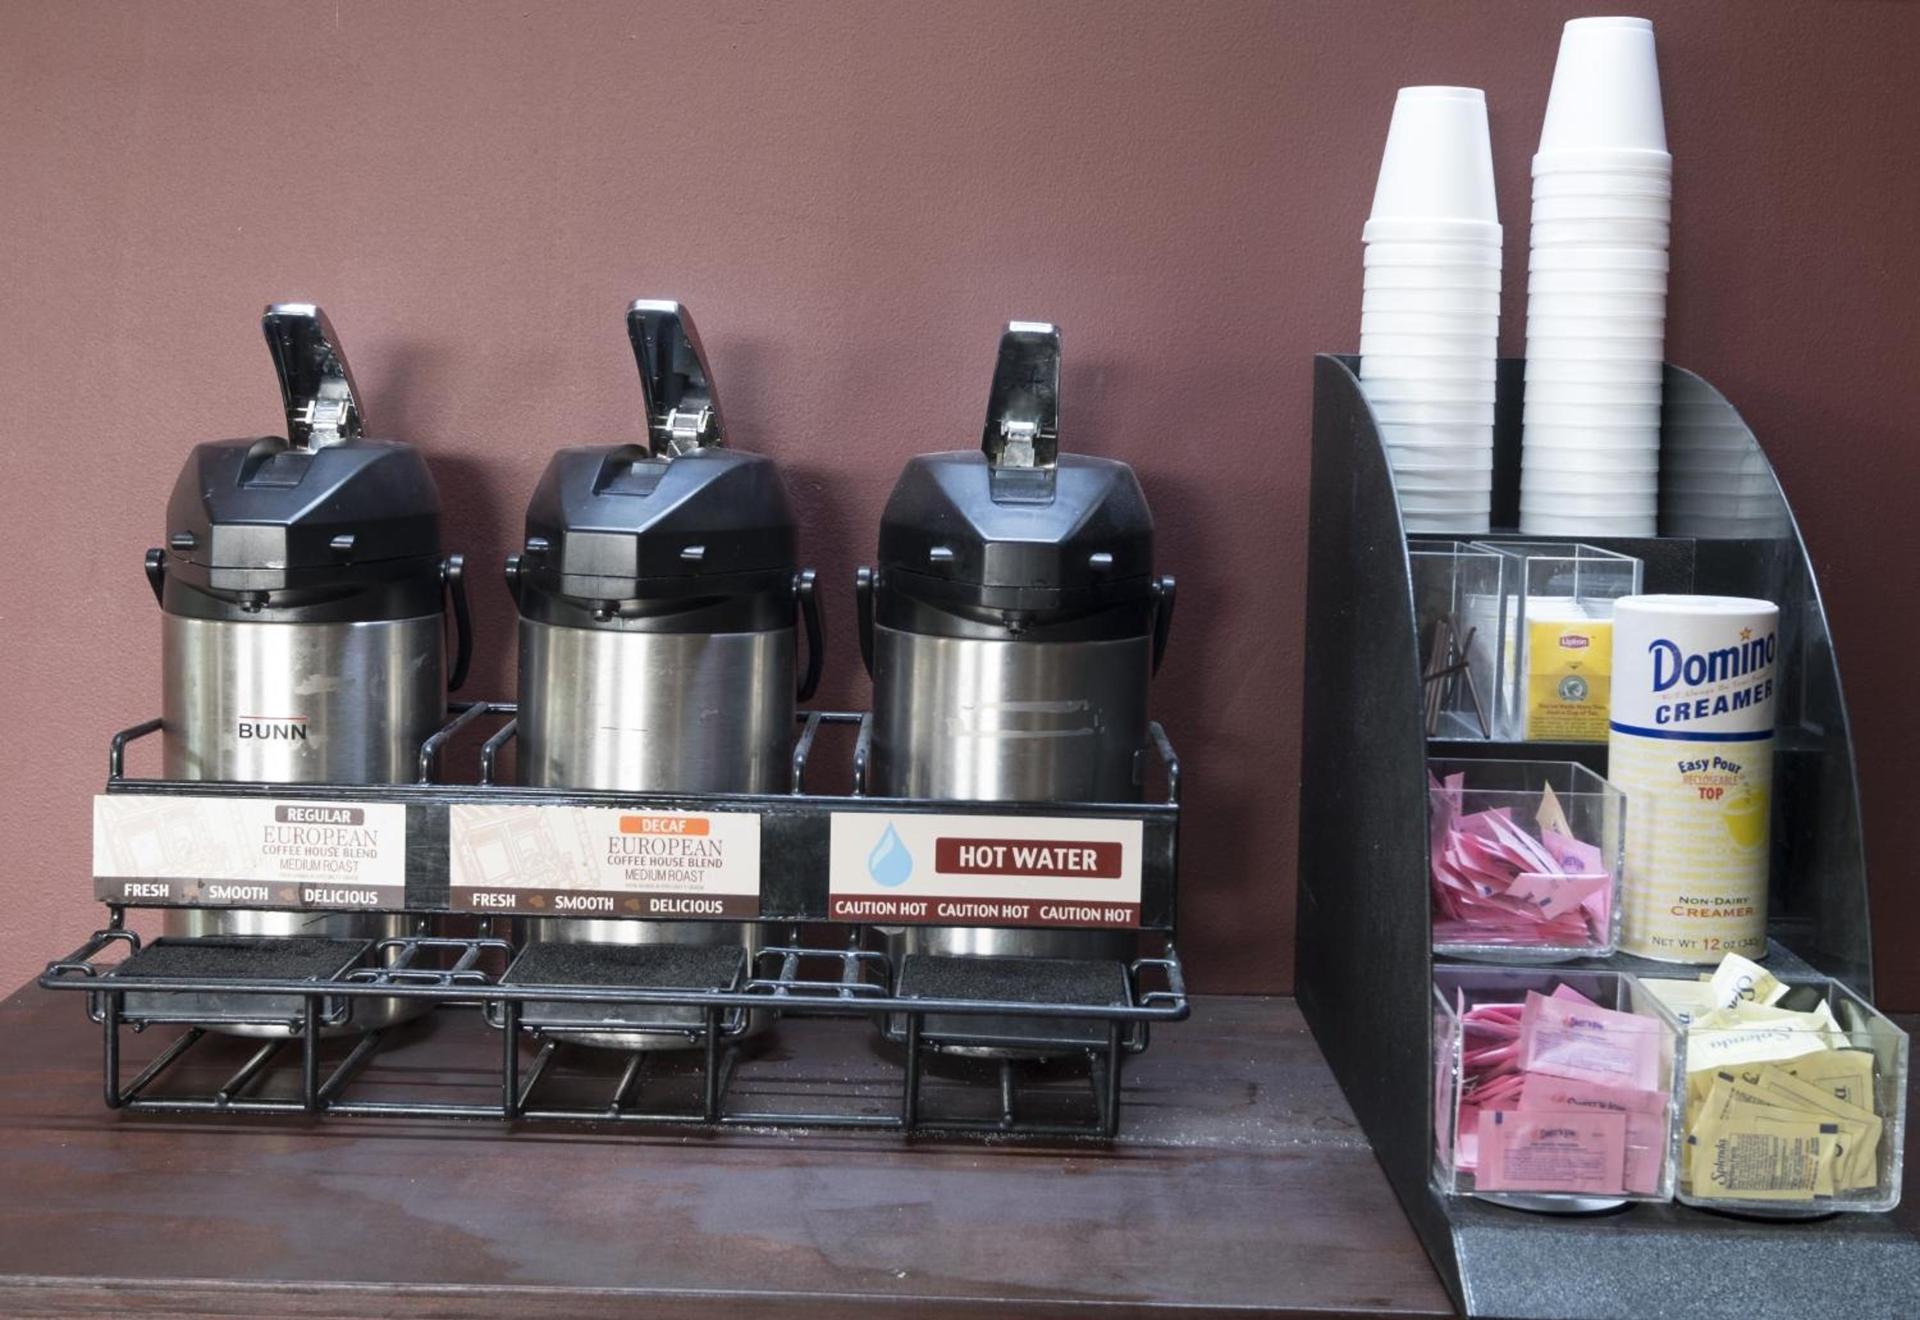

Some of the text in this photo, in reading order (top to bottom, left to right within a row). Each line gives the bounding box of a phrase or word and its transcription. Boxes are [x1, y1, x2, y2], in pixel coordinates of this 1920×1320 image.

[1649, 629, 1775, 692] Domino
[1656, 679, 1773, 725] CREAMER
[239, 723, 307, 740] BUNN
[1678, 756, 1742, 774] Easy Pour
[1698, 787, 1724, 800] TOP
[287, 807, 351, 823] REGULAR
[642, 818, 687, 833] DECAF
[263, 825, 379, 847] EUROPEAN
[262, 845, 377, 859] COFFEE HOUSE BLEND
[608, 836, 723, 857] EUROPEAN
[608, 855, 723, 869] COFFEE HOUSE BLEND
[959, 845, 1097, 871] HOT WATER
[280, 859, 358, 873] MEDIUM ROAST
[625, 868, 705, 883] MEDIUM ROAST
[124, 883, 169, 897] FRESH
[209, 885, 269, 900] SMOOTH
[304, 888, 378, 904] DELICIOUS
[472, 893, 516, 907] FRESH
[555, 895, 614, 910] SMOOTH
[650, 899, 723, 914] DELICIOUS
[835, 900, 928, 916] CAUTION HOT
[937, 903, 1030, 919] CAUTION HOT
[1040, 906, 1133, 922] CAUTION HOT
[1671, 905, 1754, 918] CREAMER
[1652, 936, 1674, 947] NET
[1679, 938, 1697, 949] WT
[1703, 938, 1720, 950] 12
[1711, 1137, 1728, 1186] Splenda
